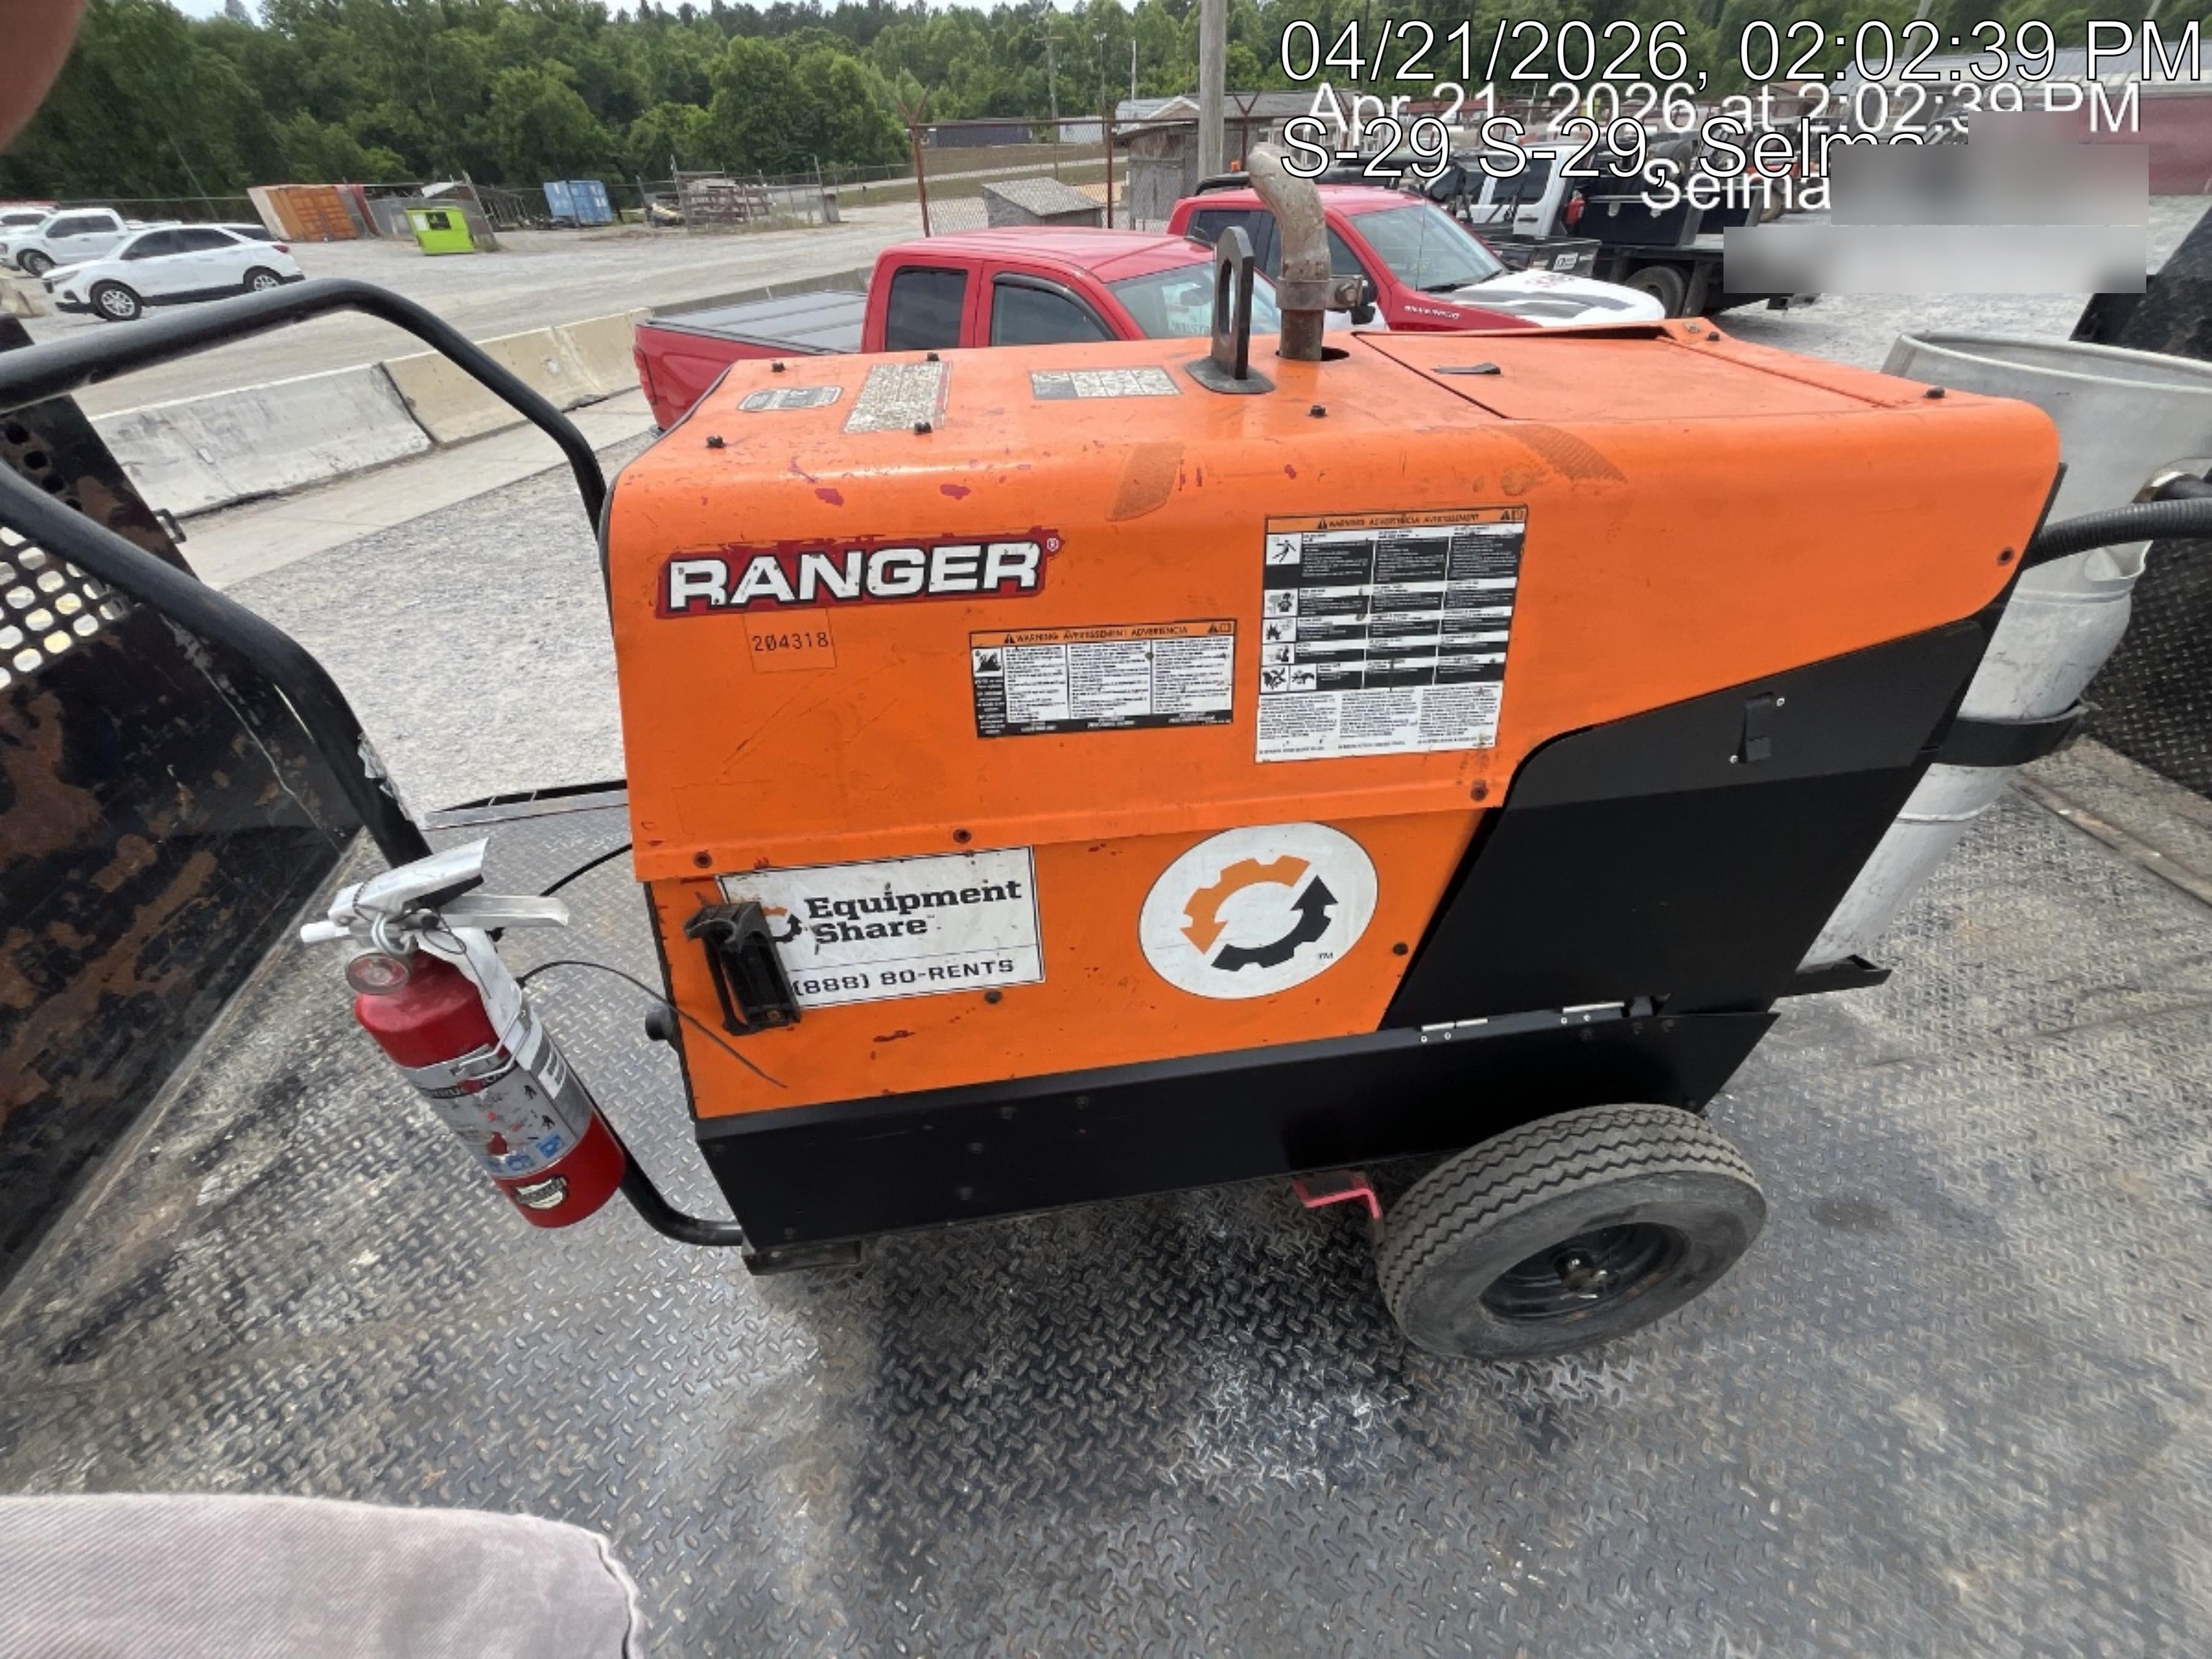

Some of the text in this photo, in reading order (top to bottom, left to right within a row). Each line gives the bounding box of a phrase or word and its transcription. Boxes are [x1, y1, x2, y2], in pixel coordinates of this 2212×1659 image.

[670, 541, 1041, 608] RANGER
[752, 632, 829, 652] 204318
[1017, 632, 1059, 643] WARNING
[804, 879, 1022, 920] Equipment
[815, 918, 929, 944] Share
[792, 959, 1015, 996] (888) 80-RENTS
